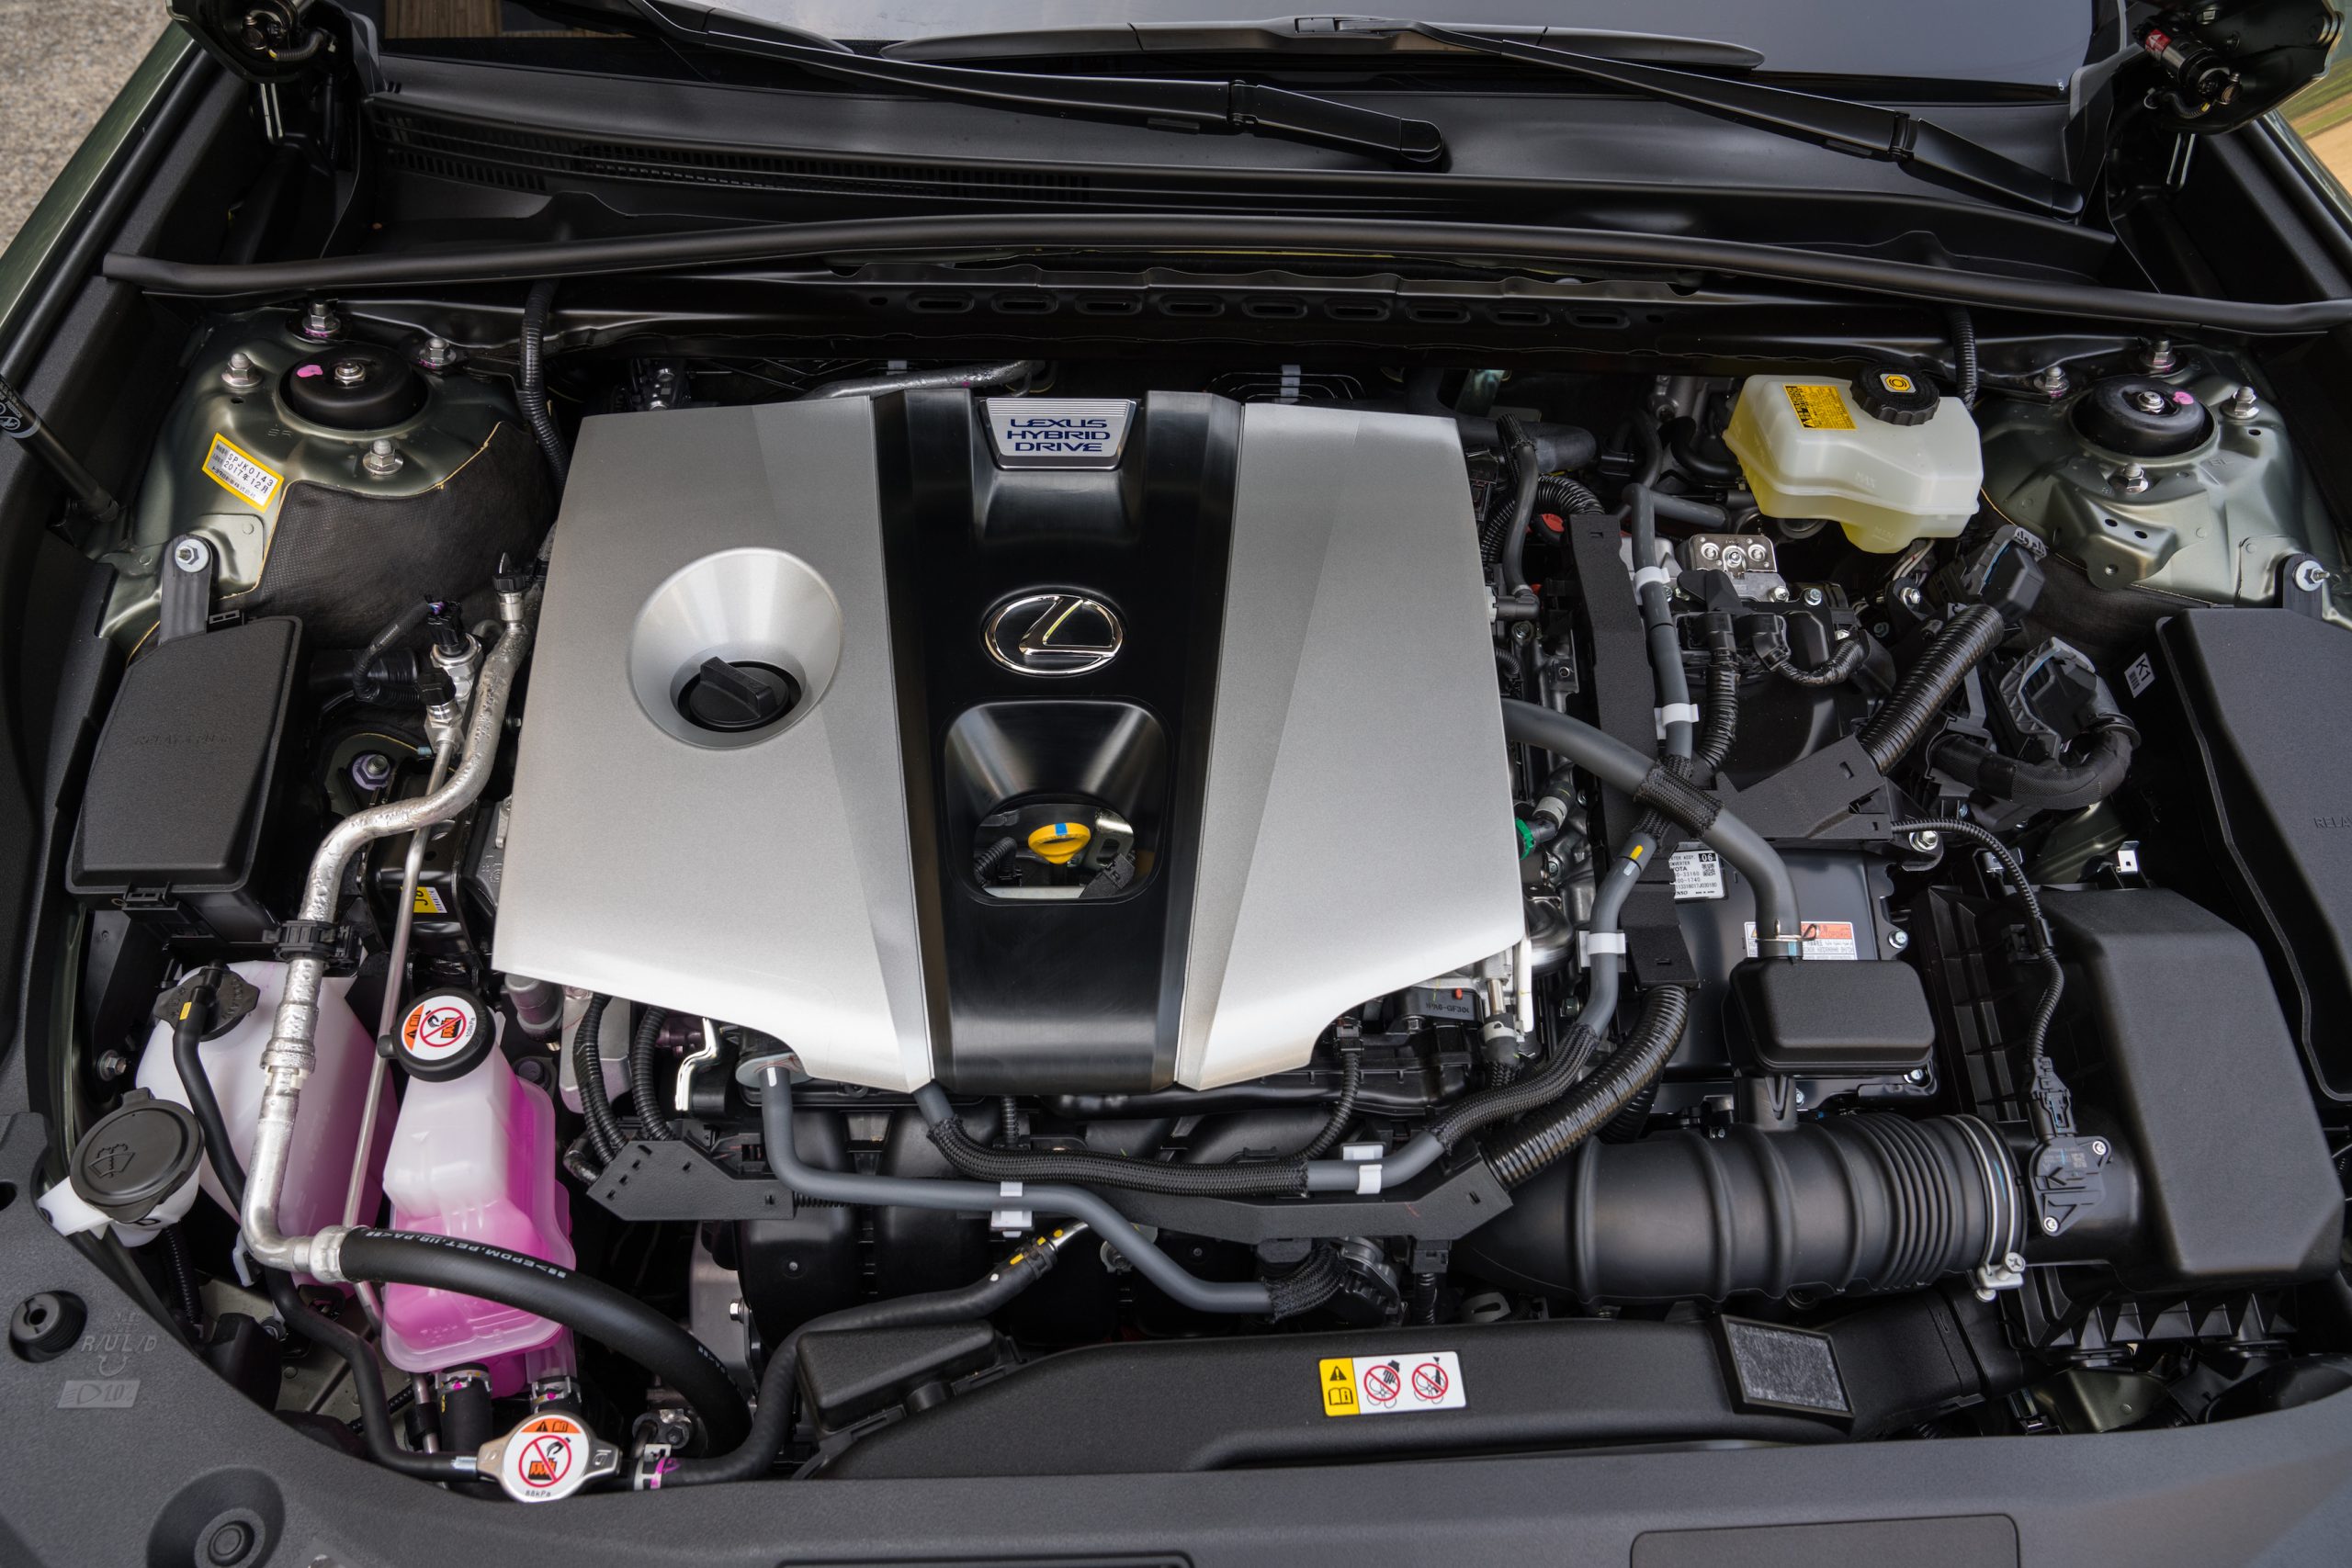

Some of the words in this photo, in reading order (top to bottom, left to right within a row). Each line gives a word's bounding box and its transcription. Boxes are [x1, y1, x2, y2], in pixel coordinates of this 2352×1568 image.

[1010, 418, 1108, 429] LEXUS
[1007, 430, 1111, 440] HYBRID
[1014, 442, 1102, 452] DRIVE
[2135, 658, 2151, 682] K1
[1702, 853, 1715, 862] 06
[525, 1489, 551, 1498] 88kPa
